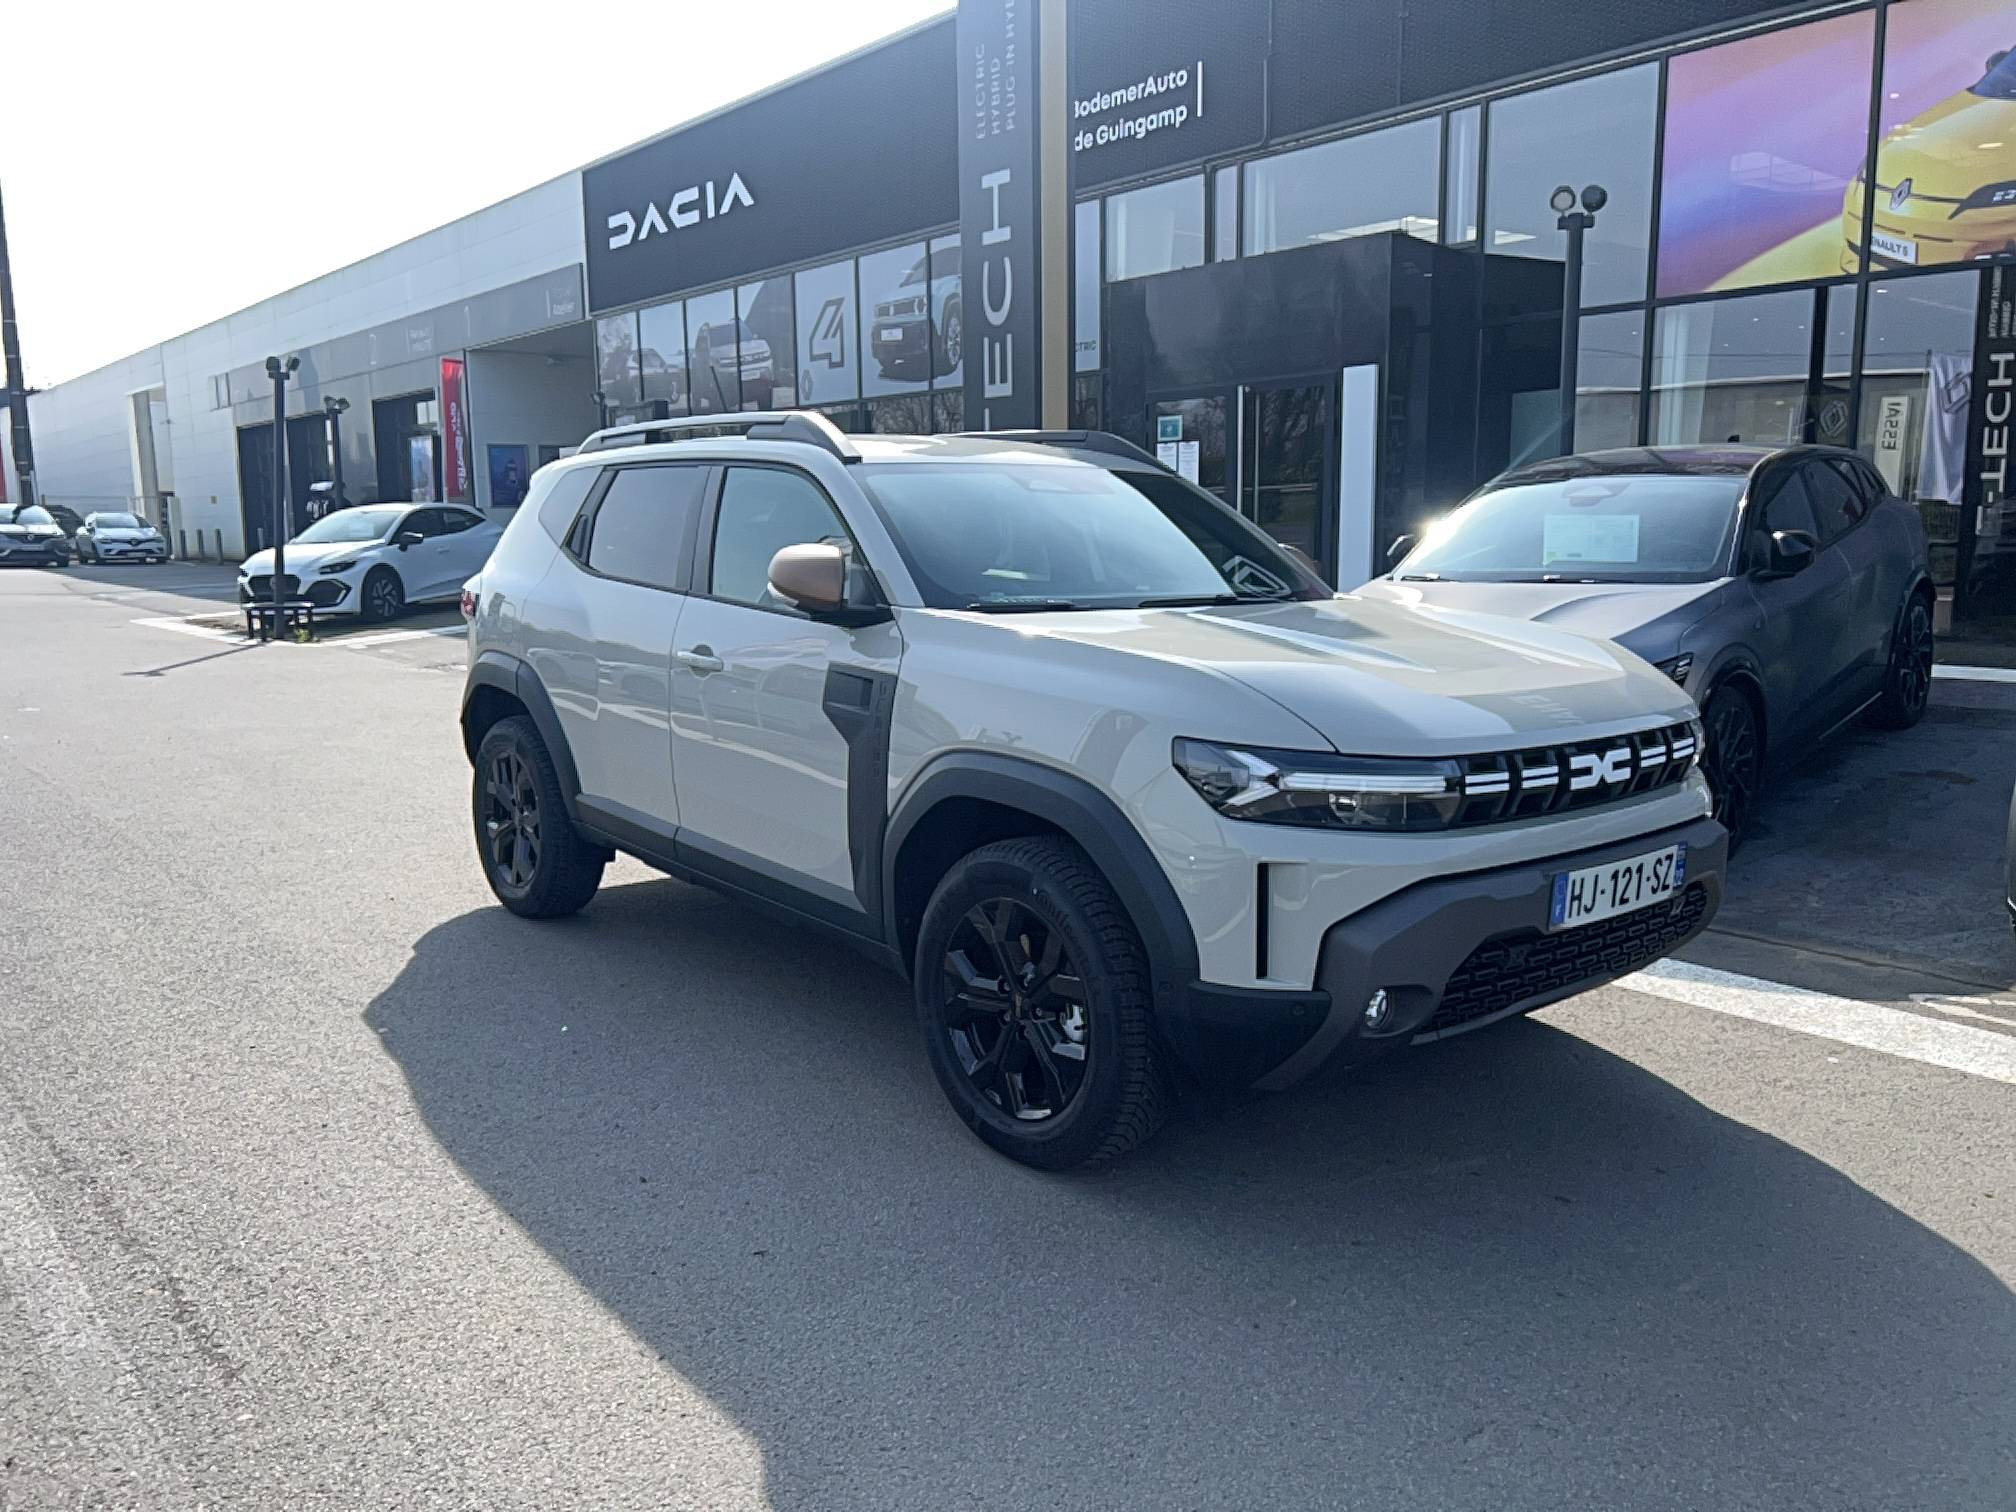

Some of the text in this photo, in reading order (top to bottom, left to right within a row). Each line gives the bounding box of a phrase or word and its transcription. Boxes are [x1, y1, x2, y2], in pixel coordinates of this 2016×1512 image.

[975, 43, 986, 140] ELECTRIC
[990, 57, 1001, 135] HYBRID
[1005, 44, 1016, 131] PLUG-IN
[1074, 104, 1188, 151] de Guingamp
[607, 171, 755, 251] DACIA
[980, 167, 1013, 432] ECH
[1567, 853, 1675, 919] HJ-121-SZ
